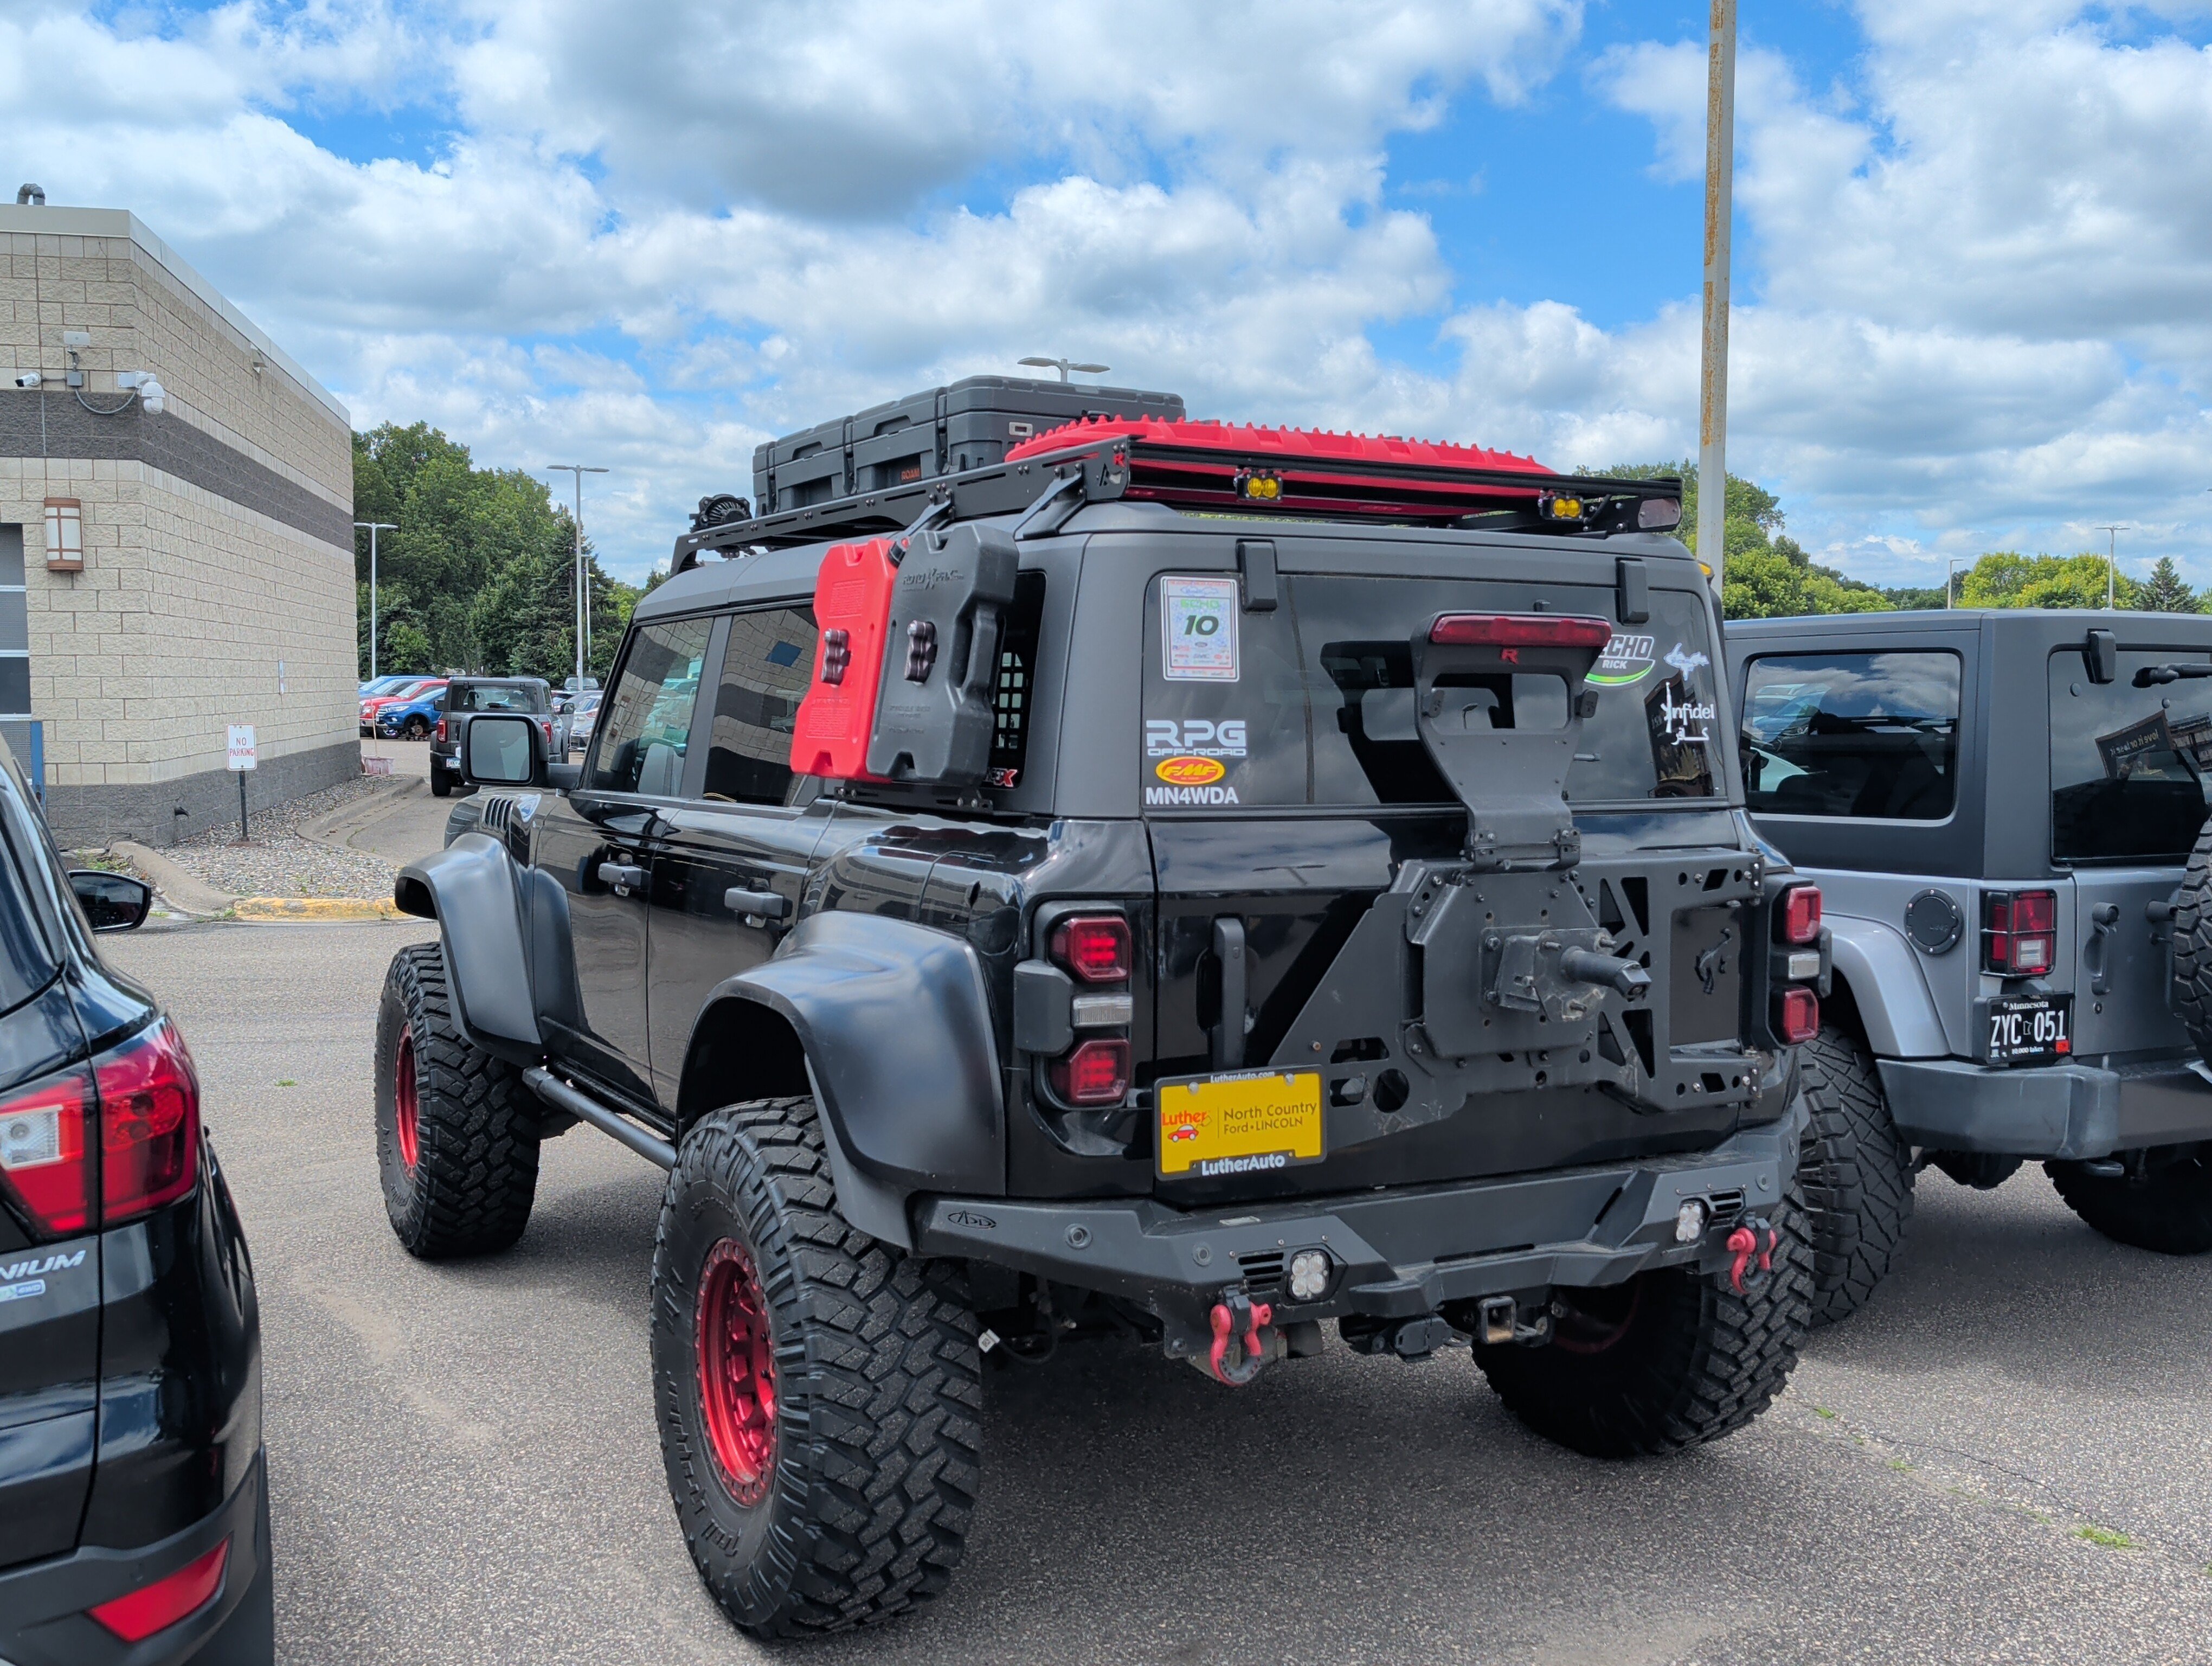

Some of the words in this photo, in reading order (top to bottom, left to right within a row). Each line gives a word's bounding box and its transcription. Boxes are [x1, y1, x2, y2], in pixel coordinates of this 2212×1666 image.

[901, 468, 919, 480] ROAM
[1185, 615, 1219, 635] 10
[1600, 637, 1650, 657] CHO
[1602, 659, 1628, 669] RICK
[1146, 720, 1246, 747] RPG
[236, 737, 247, 746] NO
[229, 747, 255, 757] PARKING
[1148, 748, 1246, 756] OFF-ROAD
[1163, 764, 1218, 777] FMF
[1146, 786, 1239, 805] MN4WDA
[2008, 1001, 2049, 1010] Minnesota
[1990, 1014, 2022, 1047] ZYC
[2034, 1010, 2066, 1043] 051
[1210, 1071, 1275, 1084] LutherAuto.com
[1161, 1111, 1207, 1126] Luther
[1224, 1106, 1262, 1121] North
[1266, 1101, 1317, 1117] Country
[1224, 1121, 1249, 1135] Ford
[1256, 1117, 1303, 1131] LINCOLN
[1201, 1154, 1285, 1176] LutherAuto
